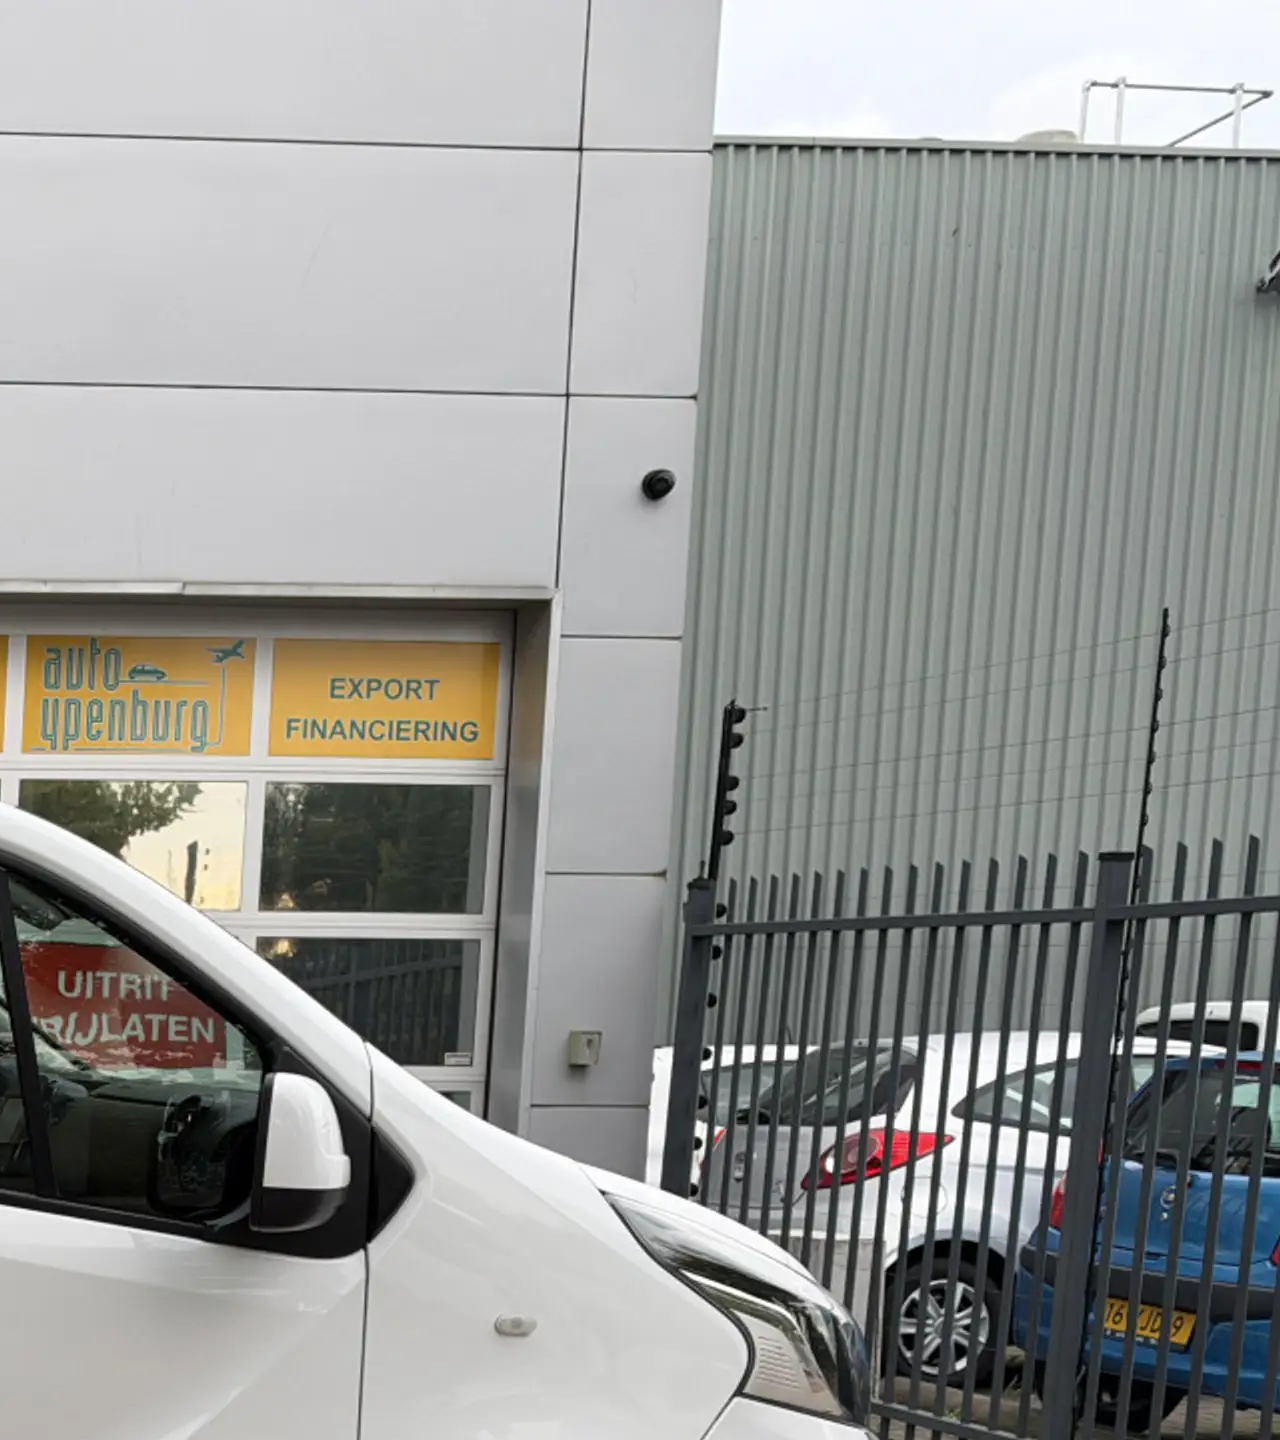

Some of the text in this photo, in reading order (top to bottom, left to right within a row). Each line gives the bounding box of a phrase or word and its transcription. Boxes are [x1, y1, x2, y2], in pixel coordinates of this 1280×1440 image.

[43, 637, 121, 691] auto
[329, 677, 441, 700] EXPORT
[41, 688, 209, 752] ypenburg
[285, 718, 479, 742] FINANCIERING
[57, 970, 174, 1001] UITRIT
[32, 1011, 215, 1046] RIJLATEN
